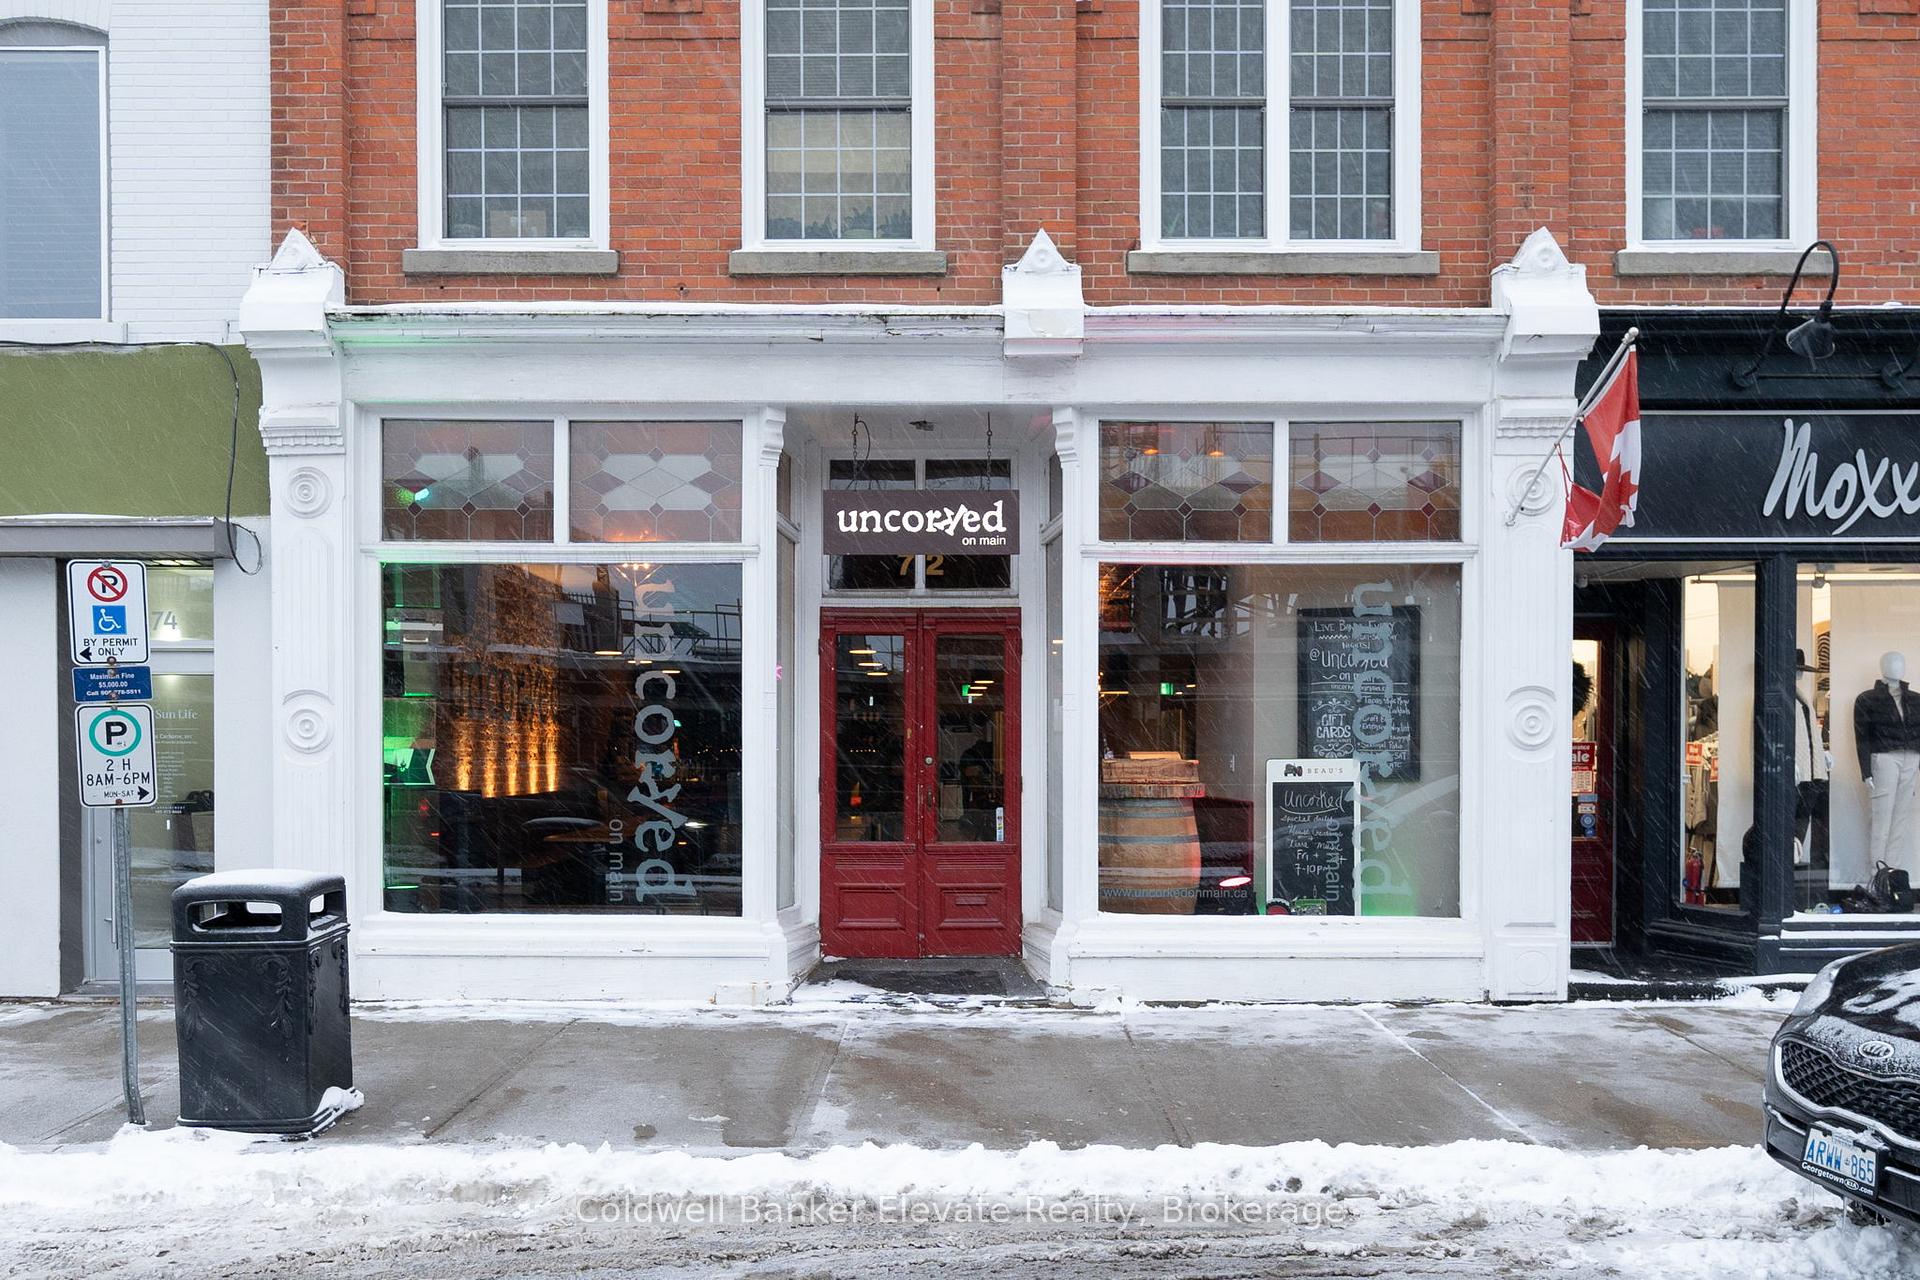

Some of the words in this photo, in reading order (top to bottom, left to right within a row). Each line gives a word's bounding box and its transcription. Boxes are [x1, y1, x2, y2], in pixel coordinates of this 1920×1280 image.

[837, 500, 1007, 536] uncorked
[962, 536, 977, 546] on
[979, 535, 1007, 546] main
[152, 611, 178, 631] 74
[83, 638, 97, 647] BY
[102, 638, 138, 647] PERMIT
[97, 647, 125, 656] ONLY
[155, 710, 176, 720] Sun
[178, 708, 199, 720] Life
[1321, 713, 1347, 726] GIFT
[1316, 725, 1351, 738] CARDS
[627, 580, 697, 903] uncorked
[1344, 579, 1412, 902] uncorked
[1572, 750, 1590, 762] ale
[106, 759, 115, 772] 2
[122, 758, 131, 771] H
[86, 771, 151, 787] 8AM-6PM
[104, 789, 135, 798] MON-SAT
[1284, 789, 1346, 813] Uncorked
[609, 818, 624, 844] on
[609, 852, 624, 902] main
[1325, 851, 1345, 902] main
[1806, 1138, 1842, 1172] ARWW
[1851, 1154, 1875, 1184] 865
